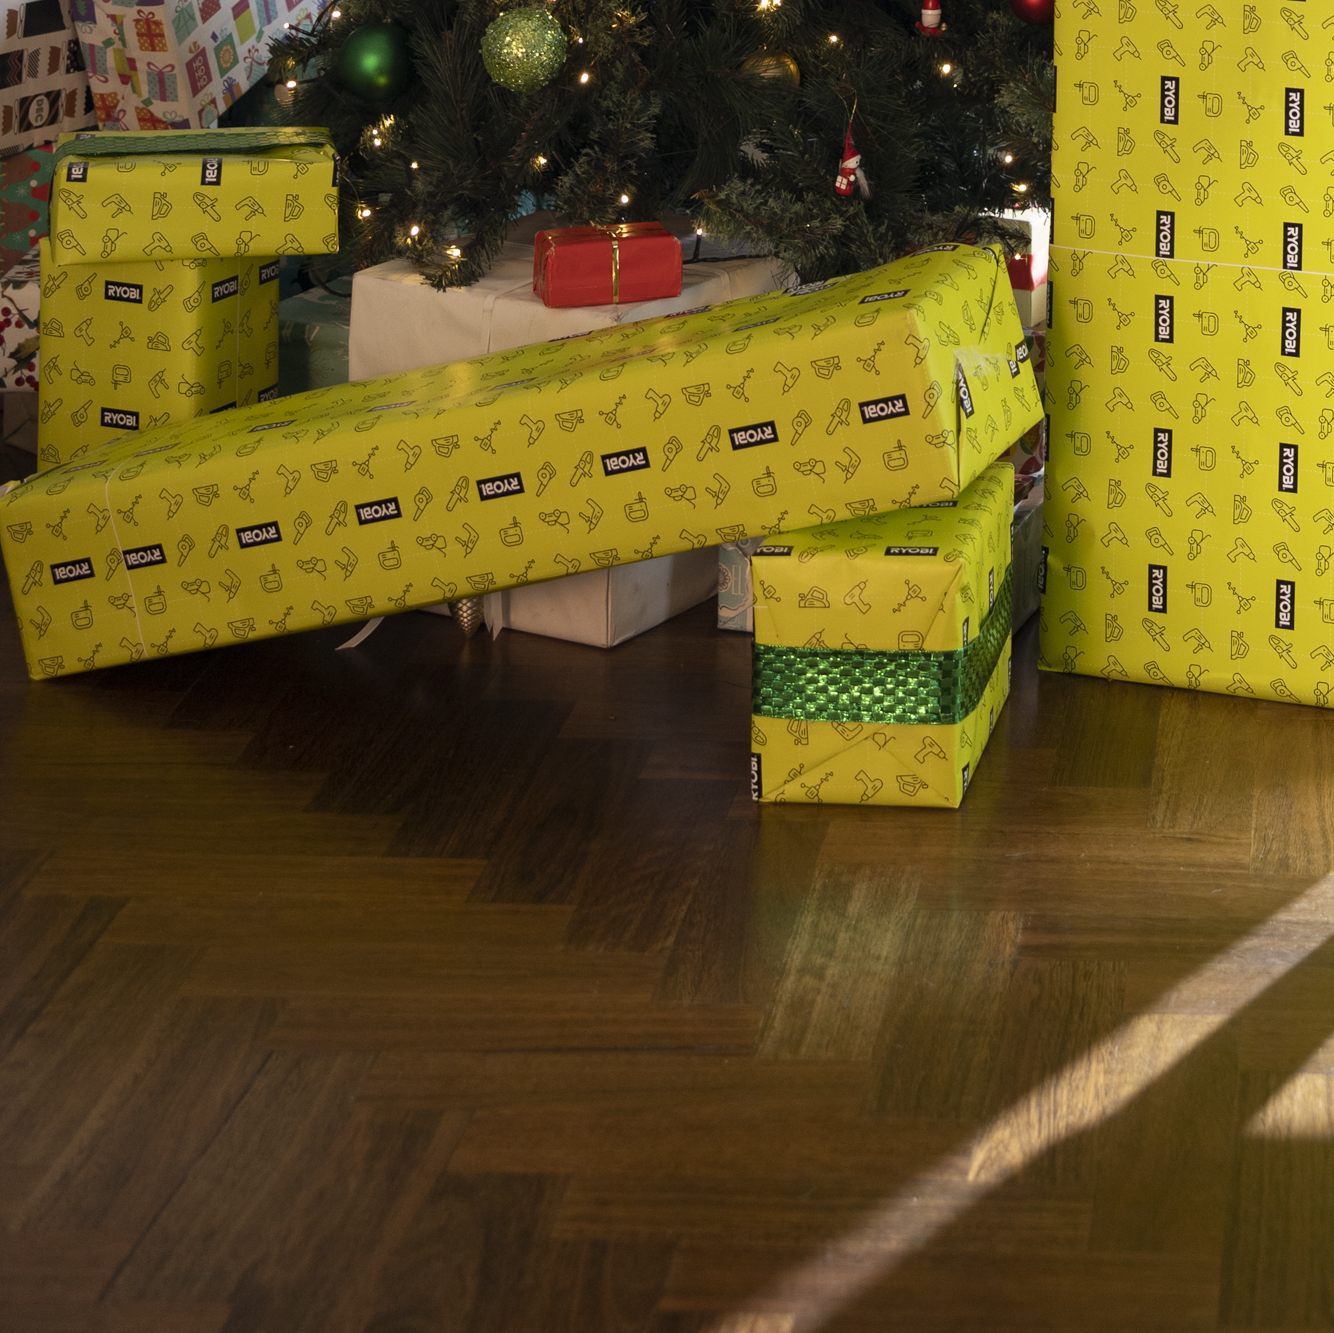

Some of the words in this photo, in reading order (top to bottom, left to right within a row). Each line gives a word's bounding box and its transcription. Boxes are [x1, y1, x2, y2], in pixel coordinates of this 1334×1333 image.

[192, 55, 204, 70] HO
[195, 65, 206, 80] HO
[197, 75, 208, 89] HO
[34, 98, 45, 123] DEC
[1163, 80, 1176, 122] RYOBI
[1288, 92, 1301, 134] RYOBI
[1159, 215, 1171, 256] RYOBI
[1286, 226, 1299, 269] RYOBI
[107, 284, 140, 300] RYOBI
[213, 279, 238, 299] RYOBI
[864, 290, 905, 303] RYOBI
[1158, 299, 1170, 341] RYOBI
[1284, 311, 1297, 355] RYOBI
[103, 411, 136, 427] RYOBI
[863, 399, 906, 419] RYOBI
[733, 425, 775, 446] RYOBI
[605, 451, 646, 471] RYOBI
[1156, 432, 1169, 475] RYOBI
[1282, 447, 1295, 490] RYOBI
[481, 477, 521, 496] RYOBI
[357, 501, 398, 521] RYOBI
[240, 525, 278, 544] RYOBI
[125, 548, 163, 566] RYOBI
[756, 546, 789, 554] YOBI
[890, 546, 935, 555] RYOBI
[53, 562, 91, 580] RYOBI
[1151, 568, 1164, 610] RYOBI
[1279, 584, 1292, 627] RYOBI
